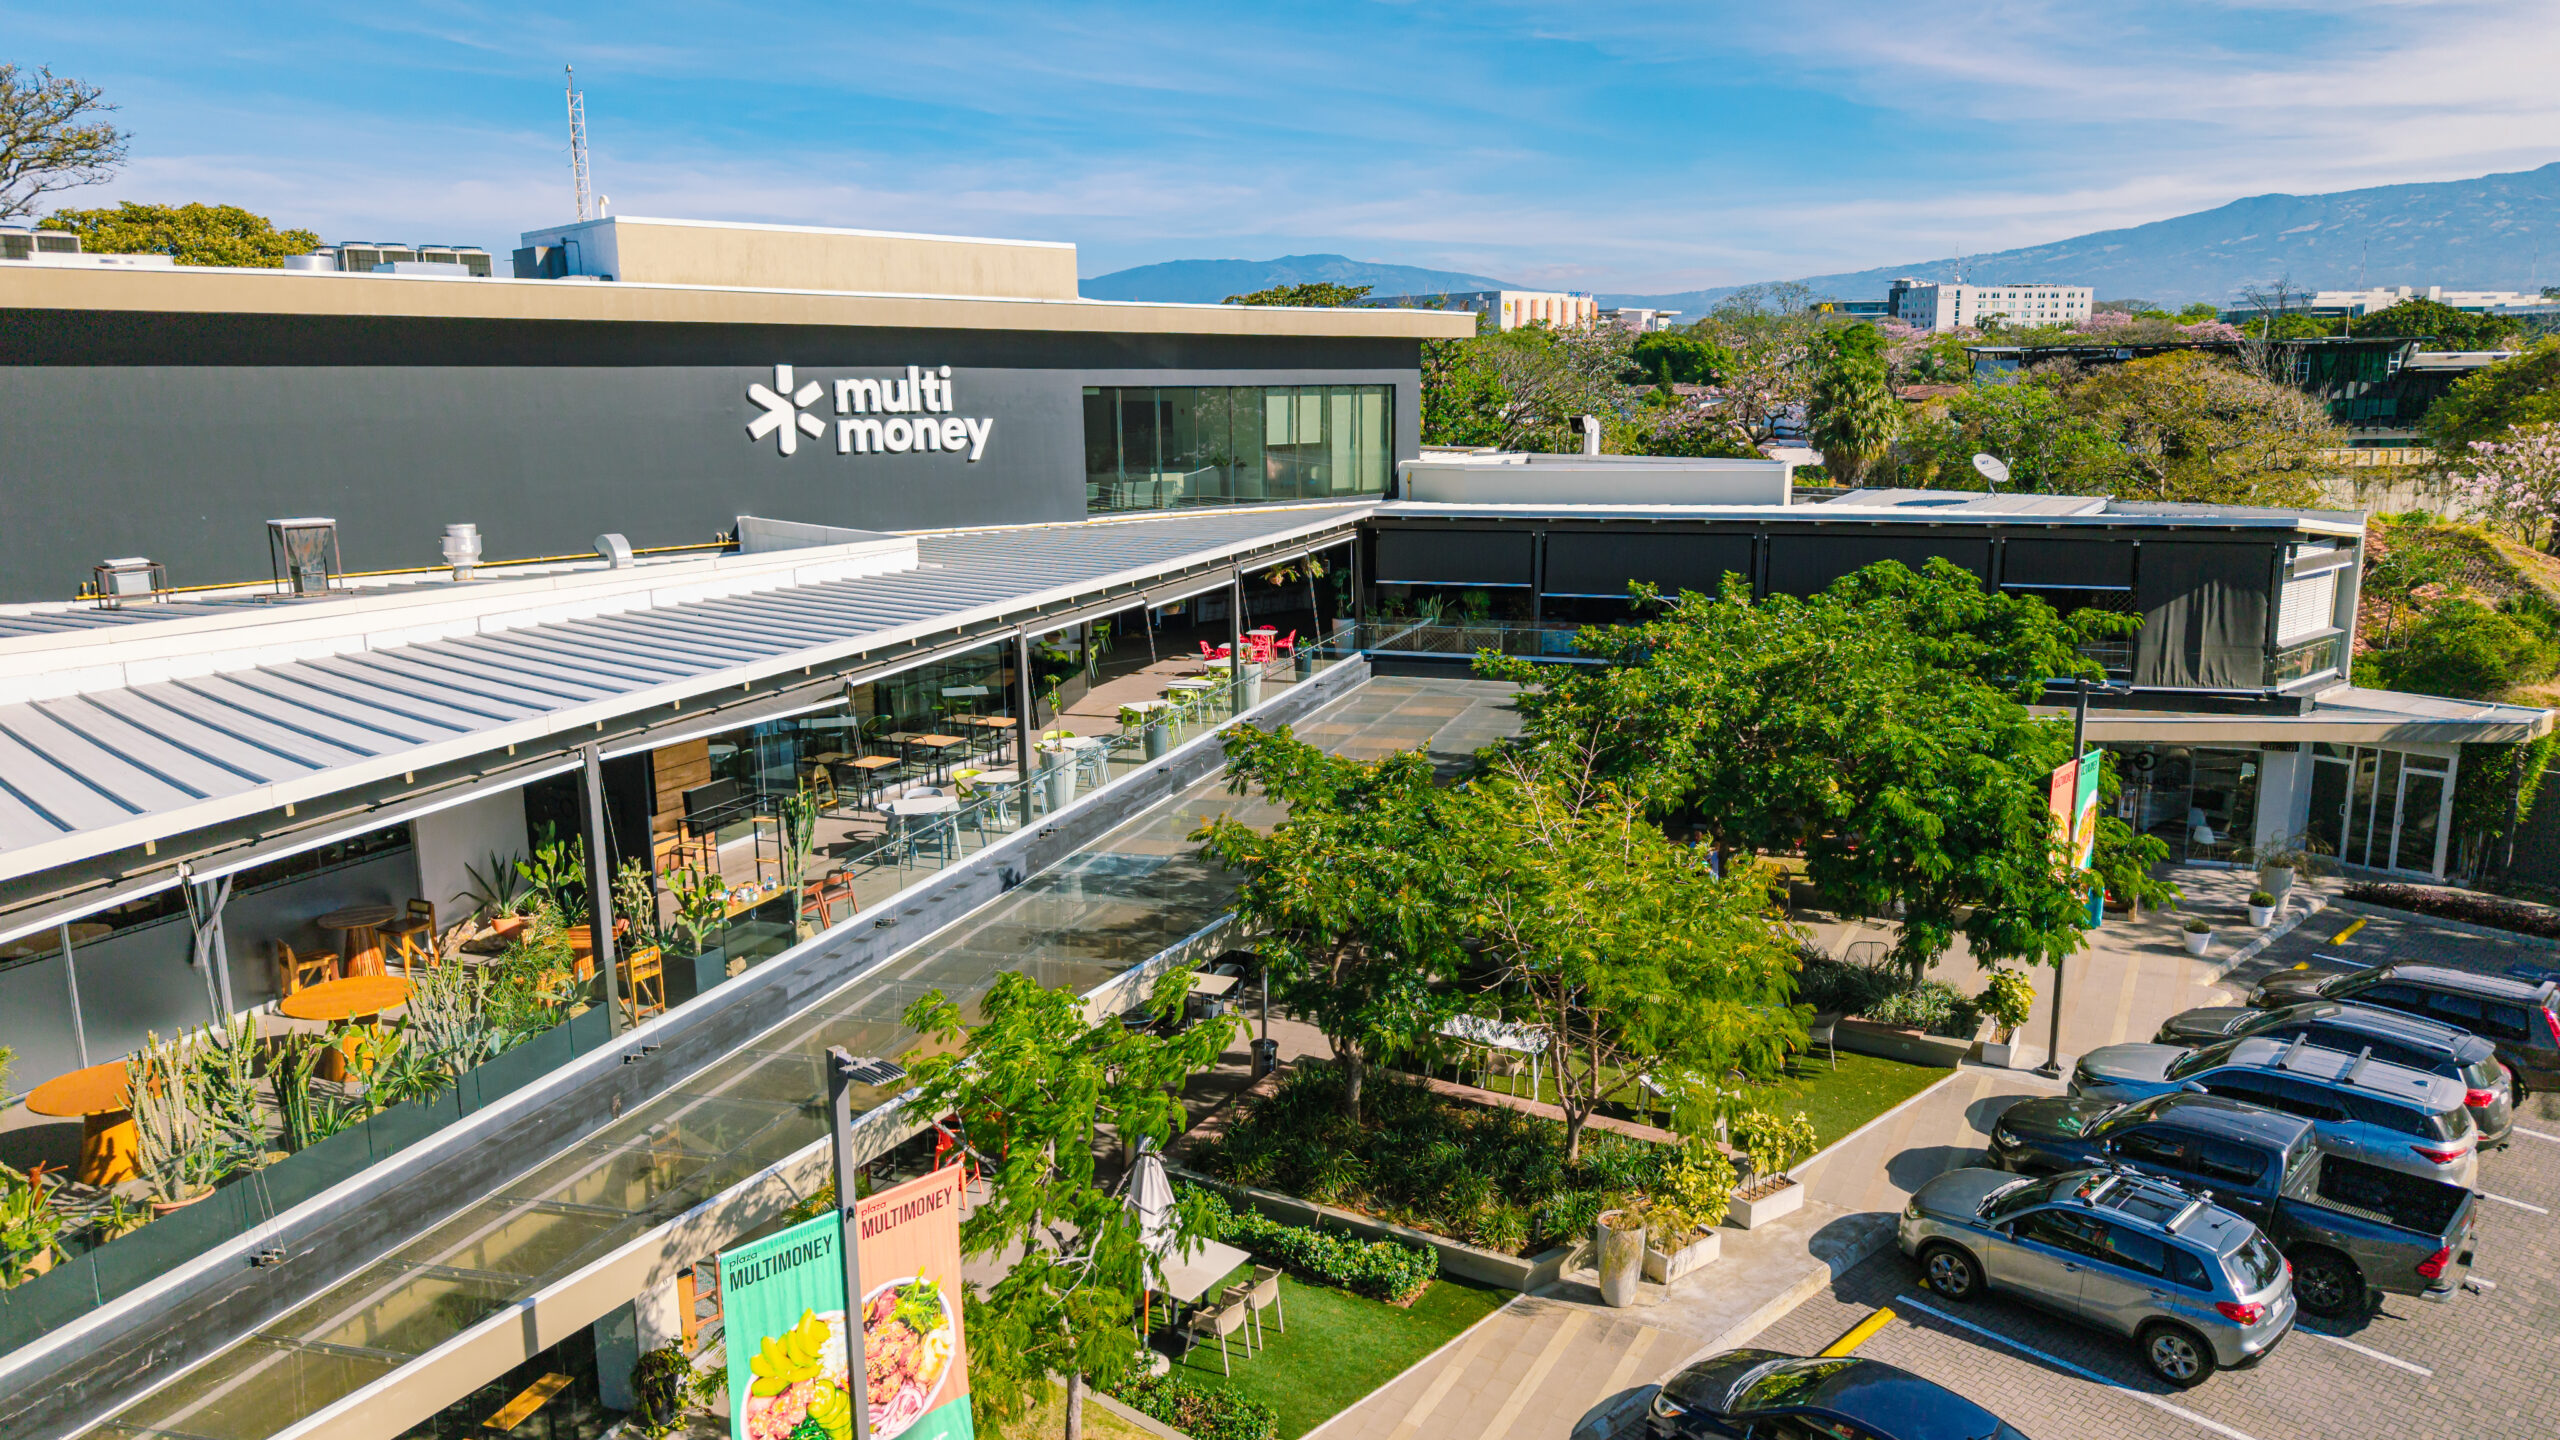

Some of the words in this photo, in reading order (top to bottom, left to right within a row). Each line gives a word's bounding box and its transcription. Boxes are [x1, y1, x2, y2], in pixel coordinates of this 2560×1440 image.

[833, 365, 952, 412] multi
[837, 417, 993, 460] money
[861, 1201, 887, 1220] plaza
[861, 1185, 952, 1240] MULTIMONEY
[729, 1251, 758, 1271] plaza
[730, 1233, 832, 1292] MULTIMONEY
